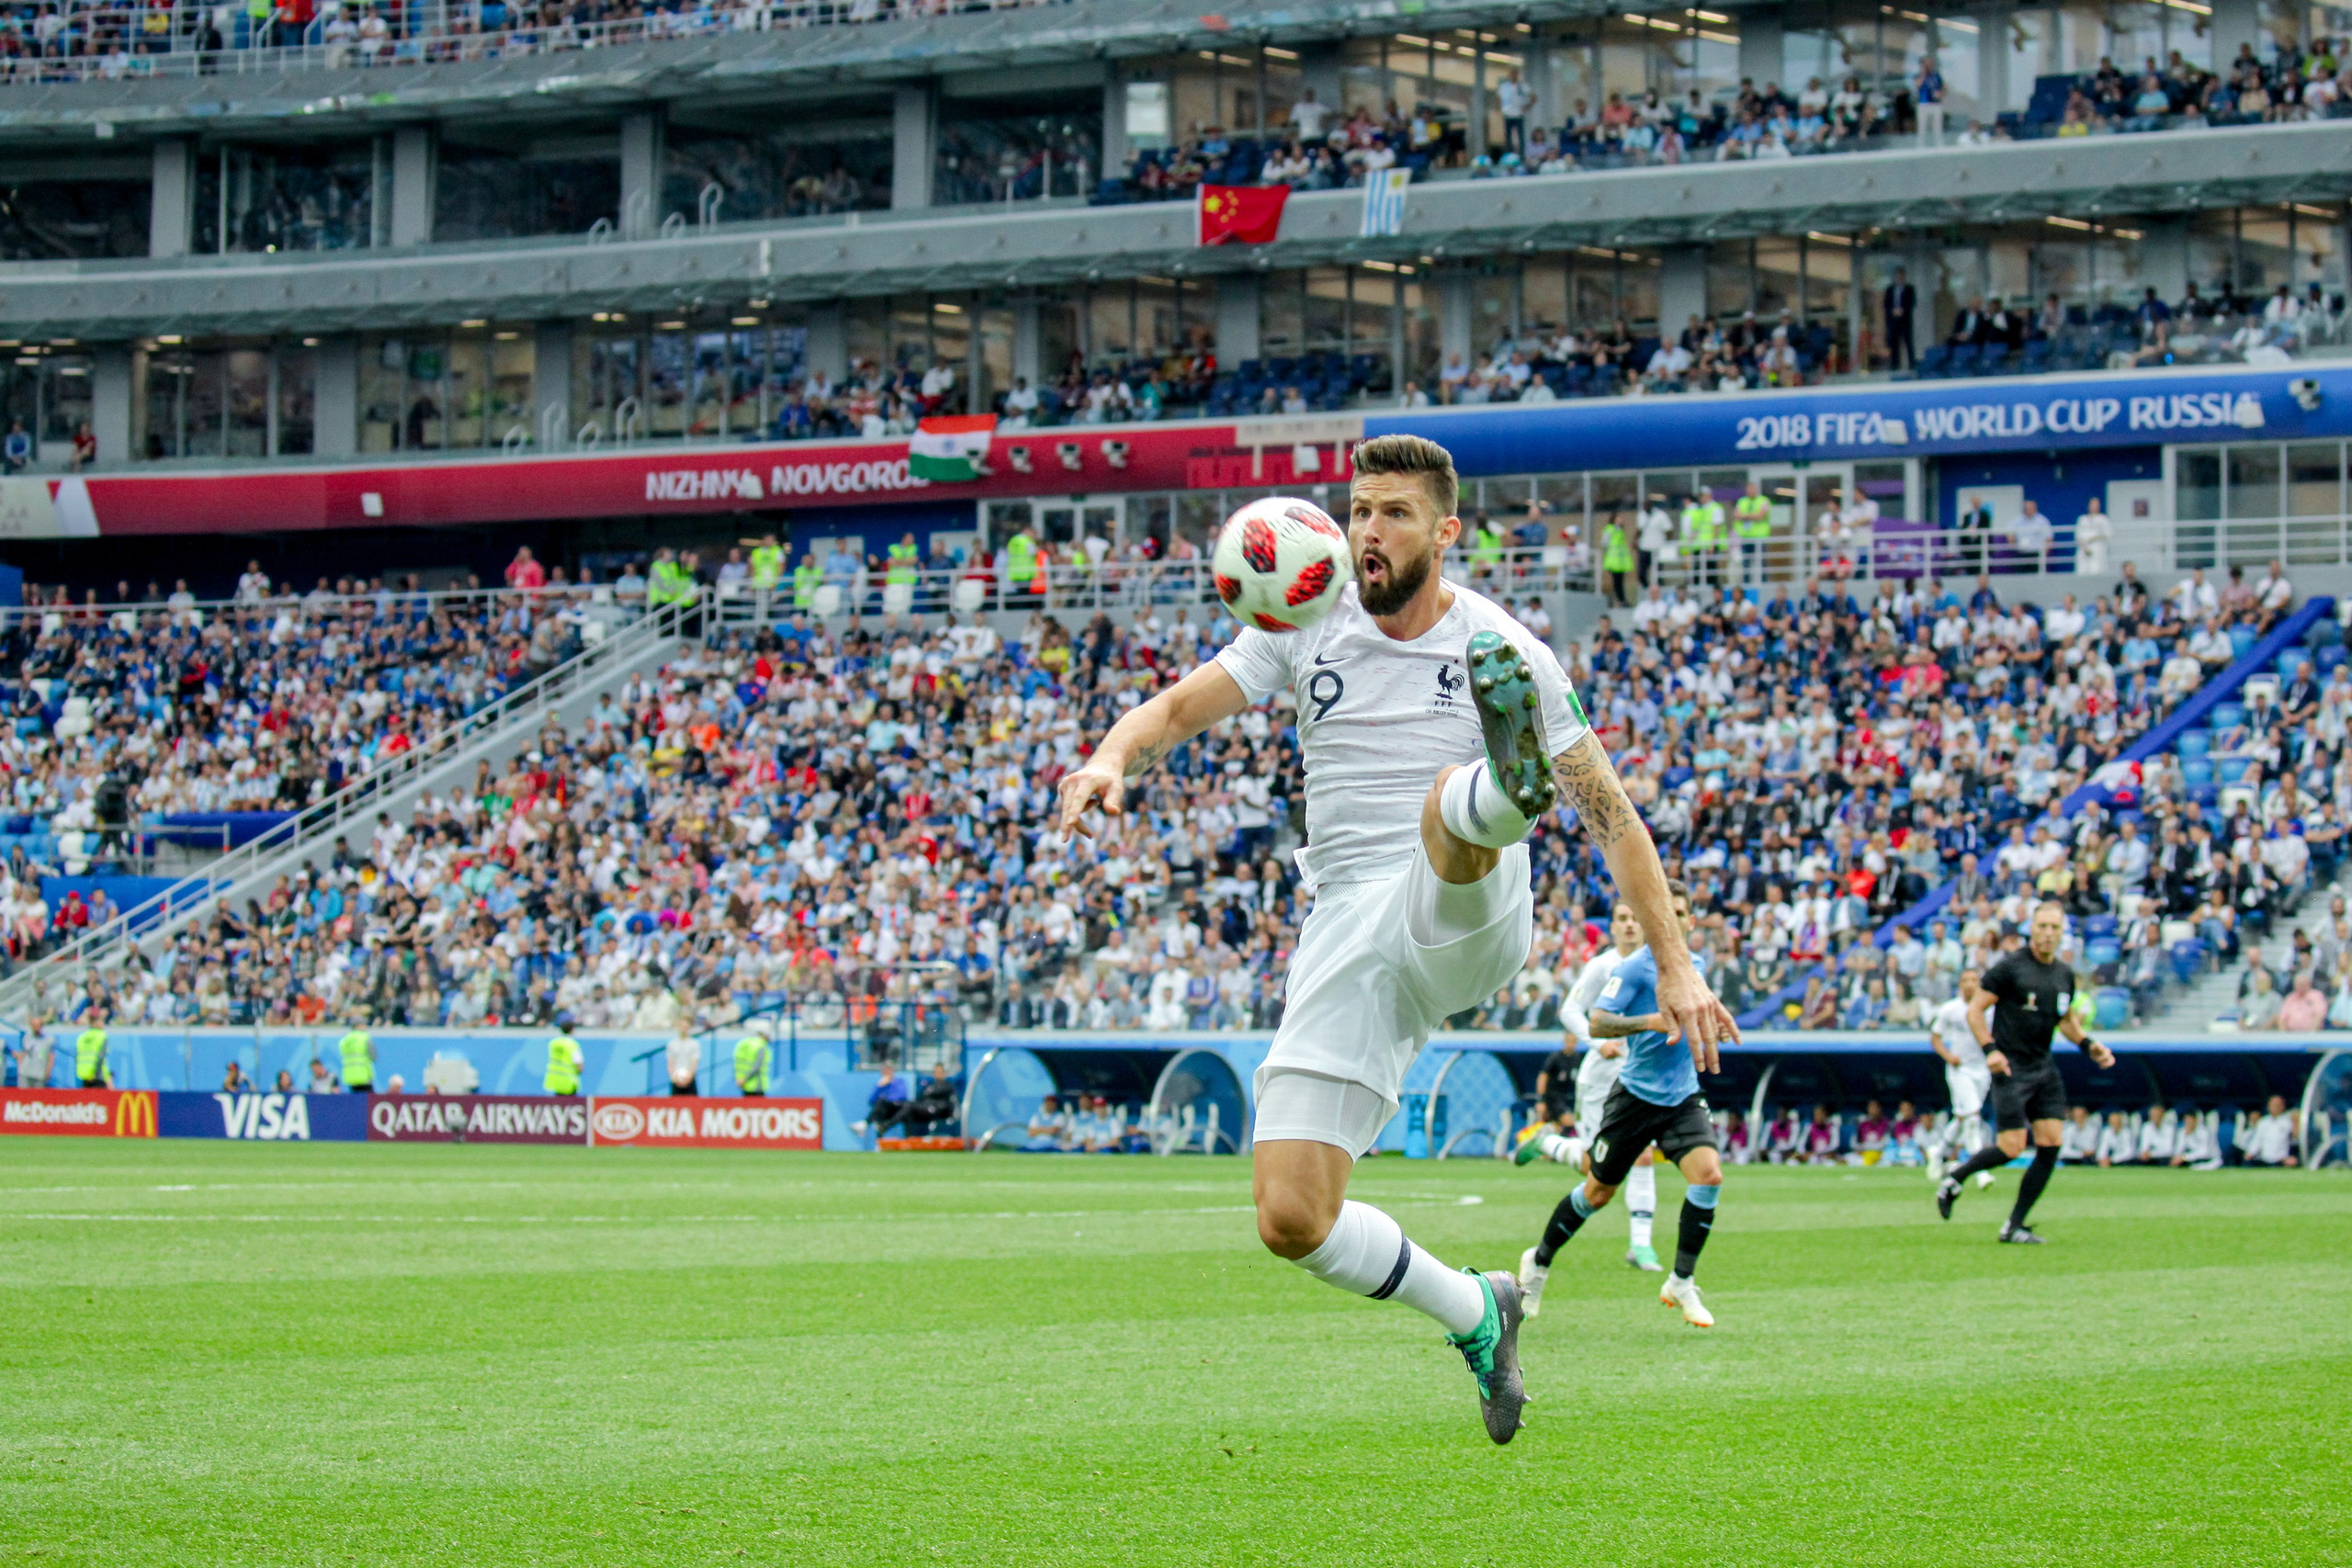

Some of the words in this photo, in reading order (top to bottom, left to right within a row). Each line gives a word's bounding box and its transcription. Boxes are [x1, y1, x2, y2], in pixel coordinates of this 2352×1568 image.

[1735, 413, 1812, 450] 2018
[1815, 411, 1887, 446] FIFA
[1914, 403, 2040, 441] WORLD
[2046, 399, 2120, 434] CUP
[772, 458, 929, 494] NOVGORO
[1310, 670, 1344, 721] 9
[4, 1100, 107, 1124] McDonald's
[212, 1093, 311, 1140] VISA
[372, 1101, 466, 1138] QATAR
[468, 1102, 586, 1136] AIRWAYS
[647, 1106, 695, 1138] KIA
[700, 1108, 820, 1140] MOTORS
